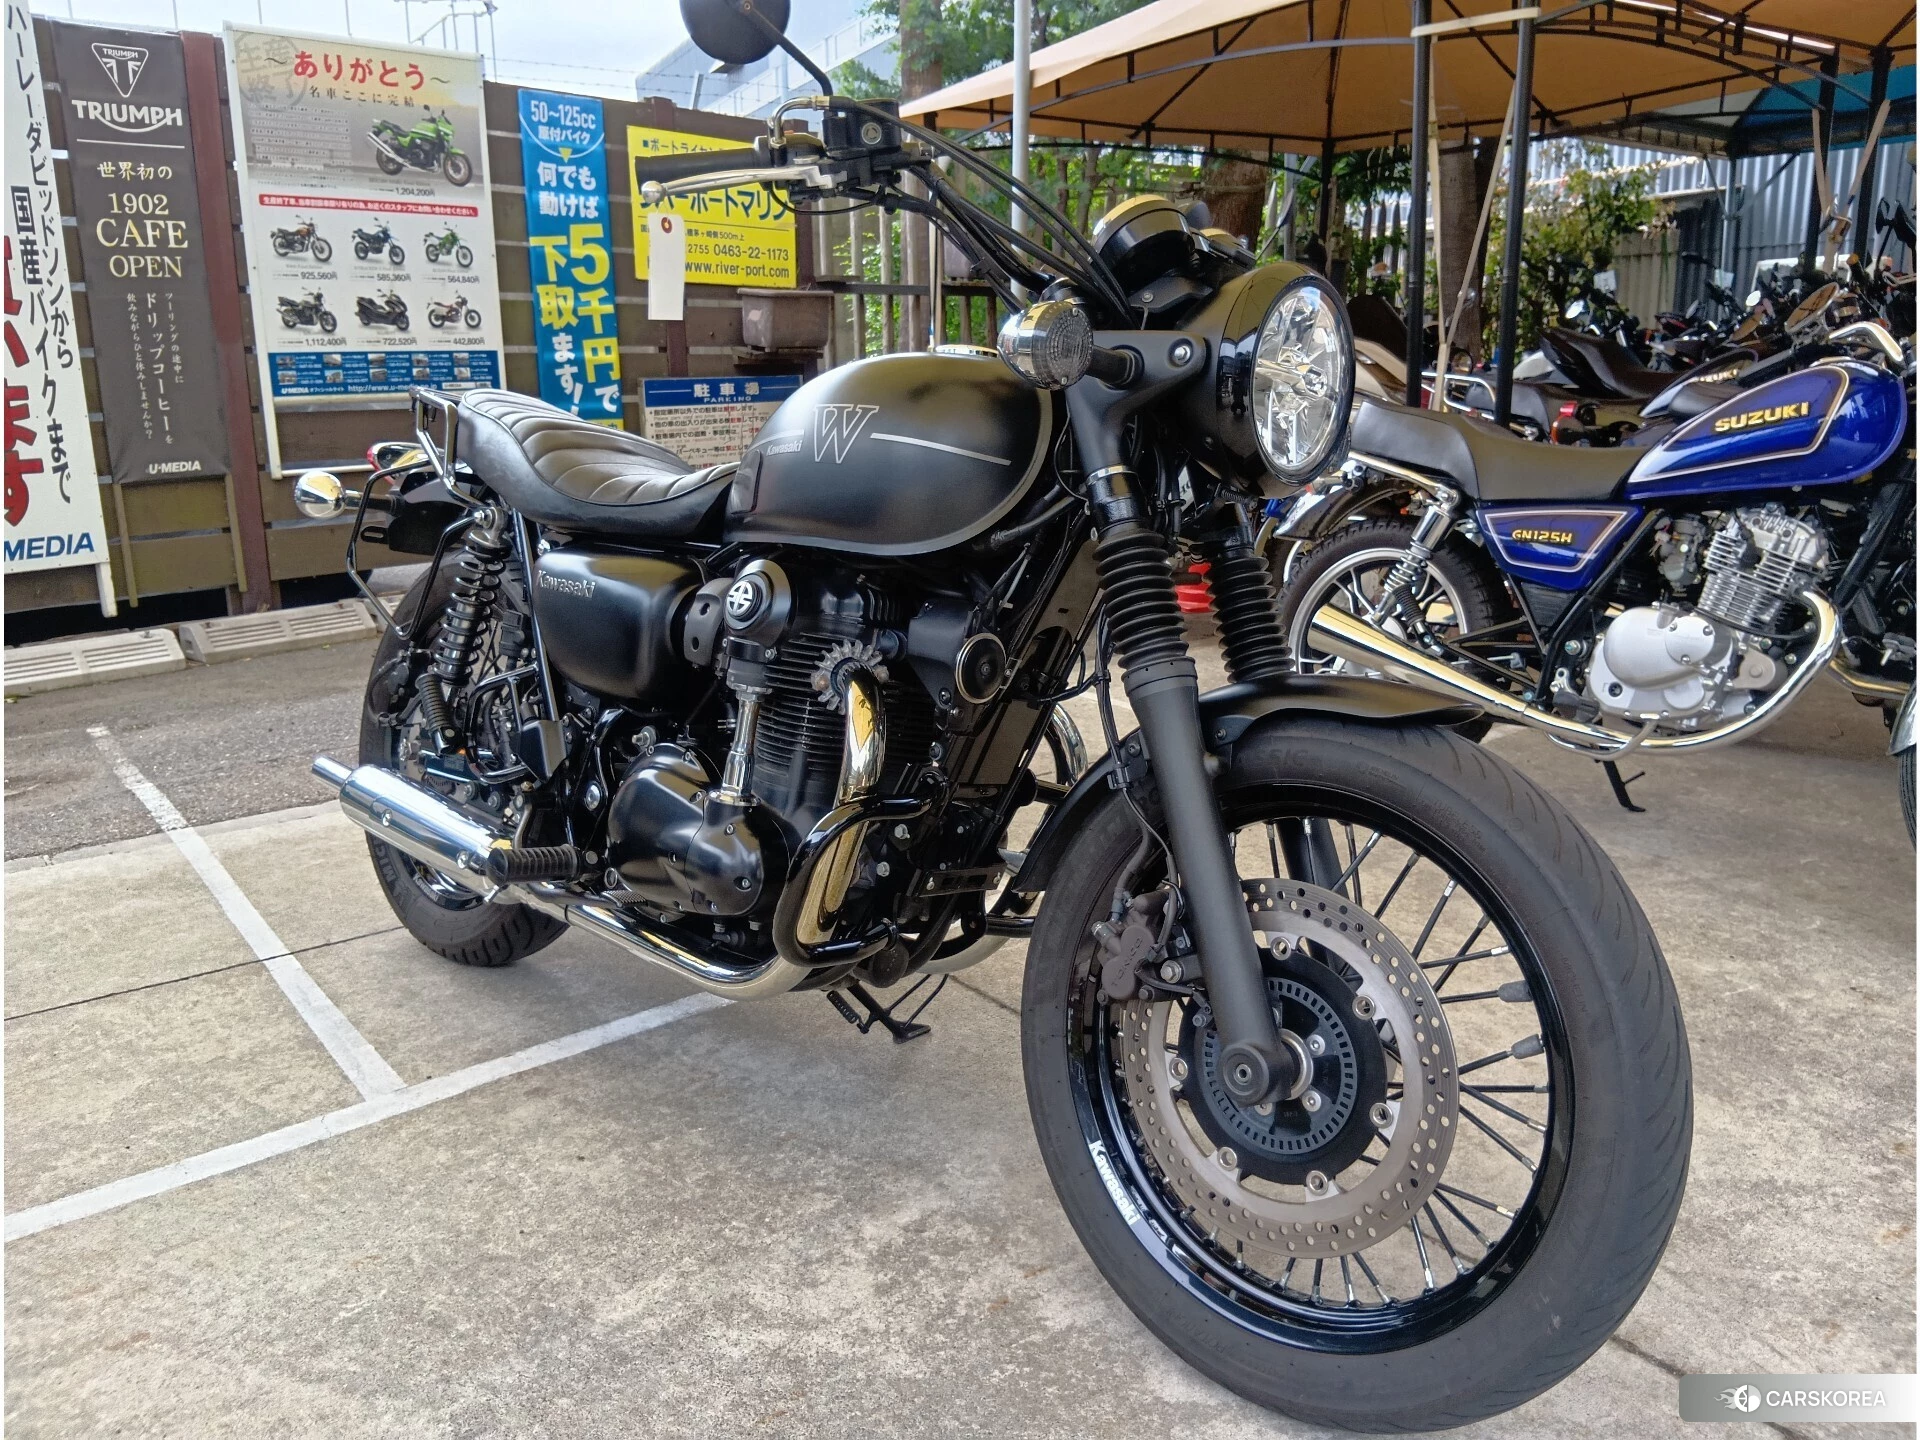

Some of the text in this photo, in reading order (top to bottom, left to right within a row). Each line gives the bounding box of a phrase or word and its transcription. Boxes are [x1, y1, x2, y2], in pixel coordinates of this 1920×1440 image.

[102, 48, 139, 59] TRIUMPH
[71, 99, 184, 132] TRIUMPH
[537, 127, 591, 145] 原付バイク
[97, 161, 173, 181] 世界初の
[537, 161, 597, 191] 何でも
[7, 4, 74, 369] ハーレーダビッドソンから
[108, 192, 170, 216] 1902
[538, 190, 599, 219] 動けば
[96, 218, 189, 249] CAFE
[109, 255, 183, 278] OPEN
[688, 243, 789, 261] 2755 0463-22-1173
[569, 223, 621, 413] 5千円で
[10, 185, 71, 504] 国産バイクまで
[165, 291, 184, 384] ツーリングの途中に
[146, 291, 174, 445] ドリップコーヒーを
[693, 382, 760, 398] 駐車場
[1714, 402, 1810, 433] SUZUKI
[766, 440, 802, 456] Kawasaki
[812, 403, 880, 464] W
[1512, 528, 1573, 544] GN125H
[537, 569, 596, 599] Kawasaki
[1088, 1140, 1142, 1226] Kawasaki
